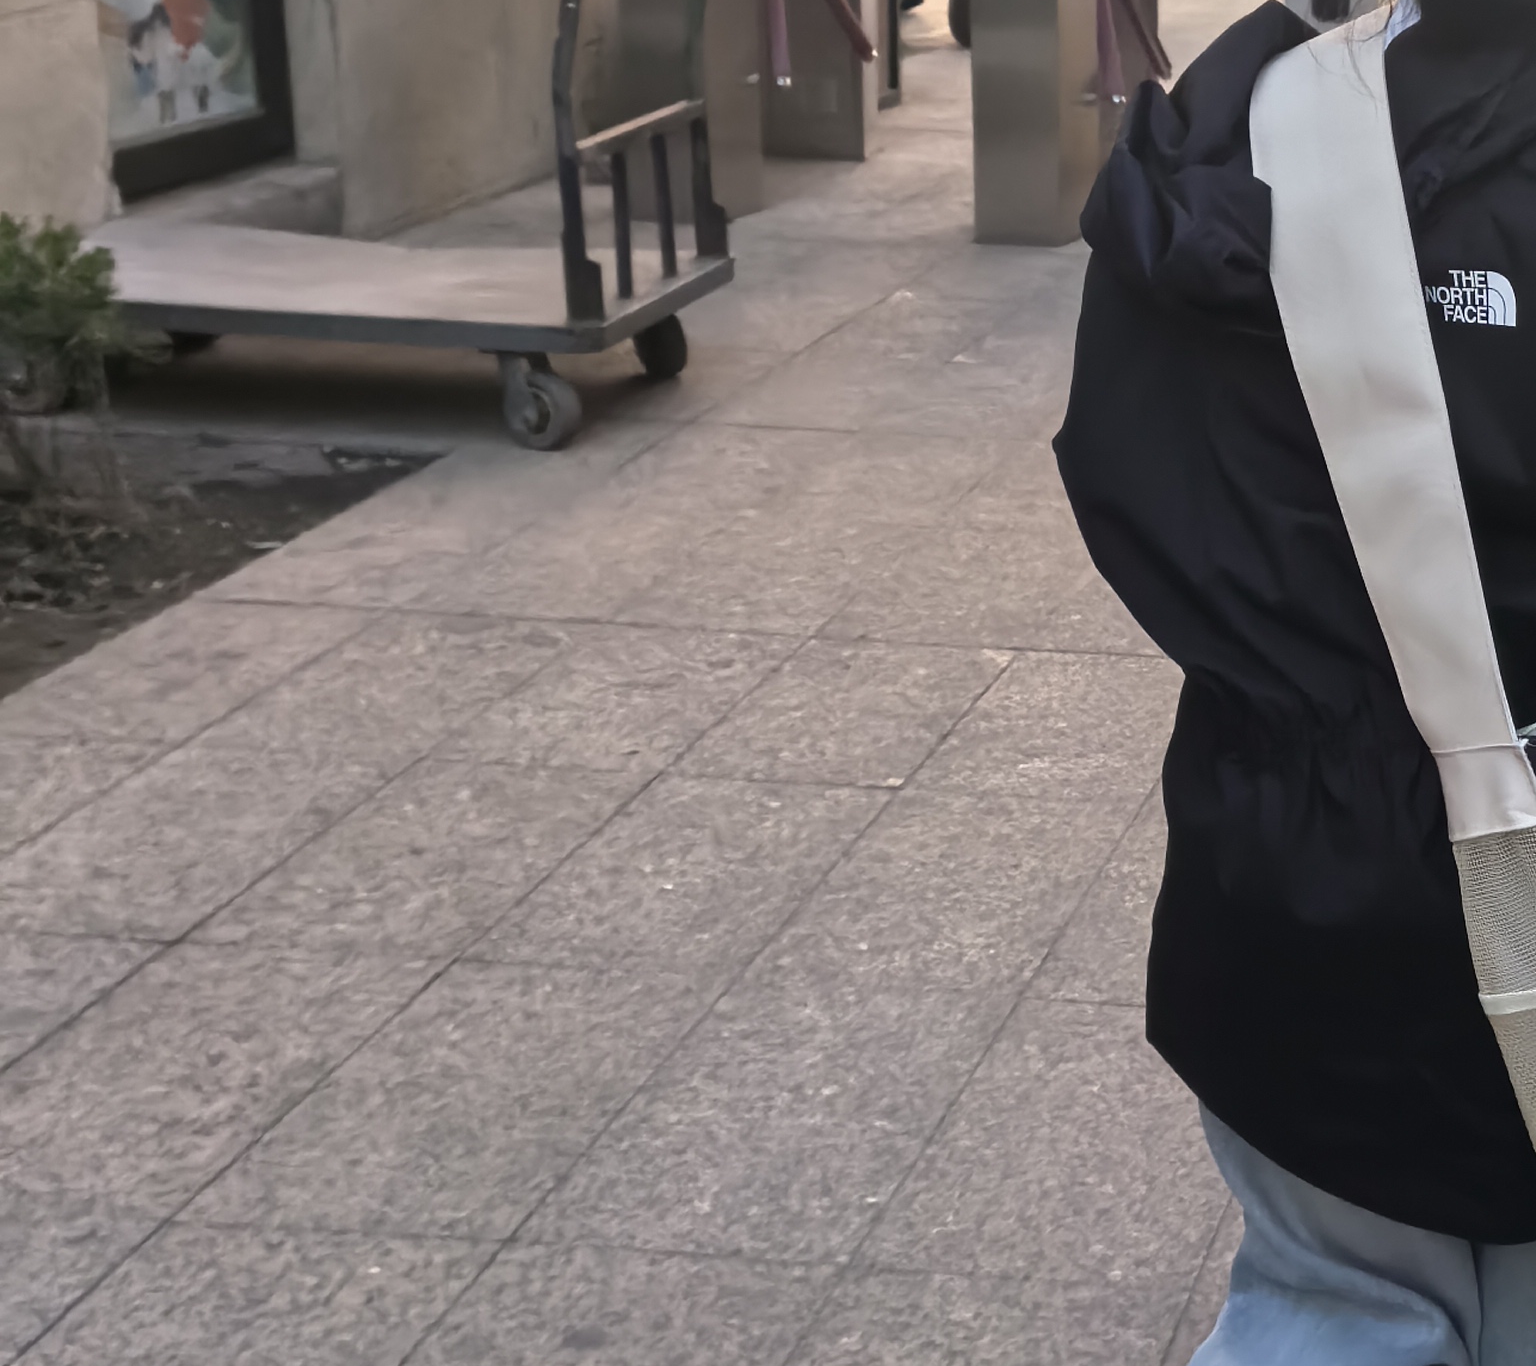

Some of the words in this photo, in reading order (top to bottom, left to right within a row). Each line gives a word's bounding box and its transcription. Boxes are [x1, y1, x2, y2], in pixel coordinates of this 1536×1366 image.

[1448, 269, 1486, 288] THE
[1425, 286, 1487, 305] NORTH
[1443, 304, 1488, 324] FACE
